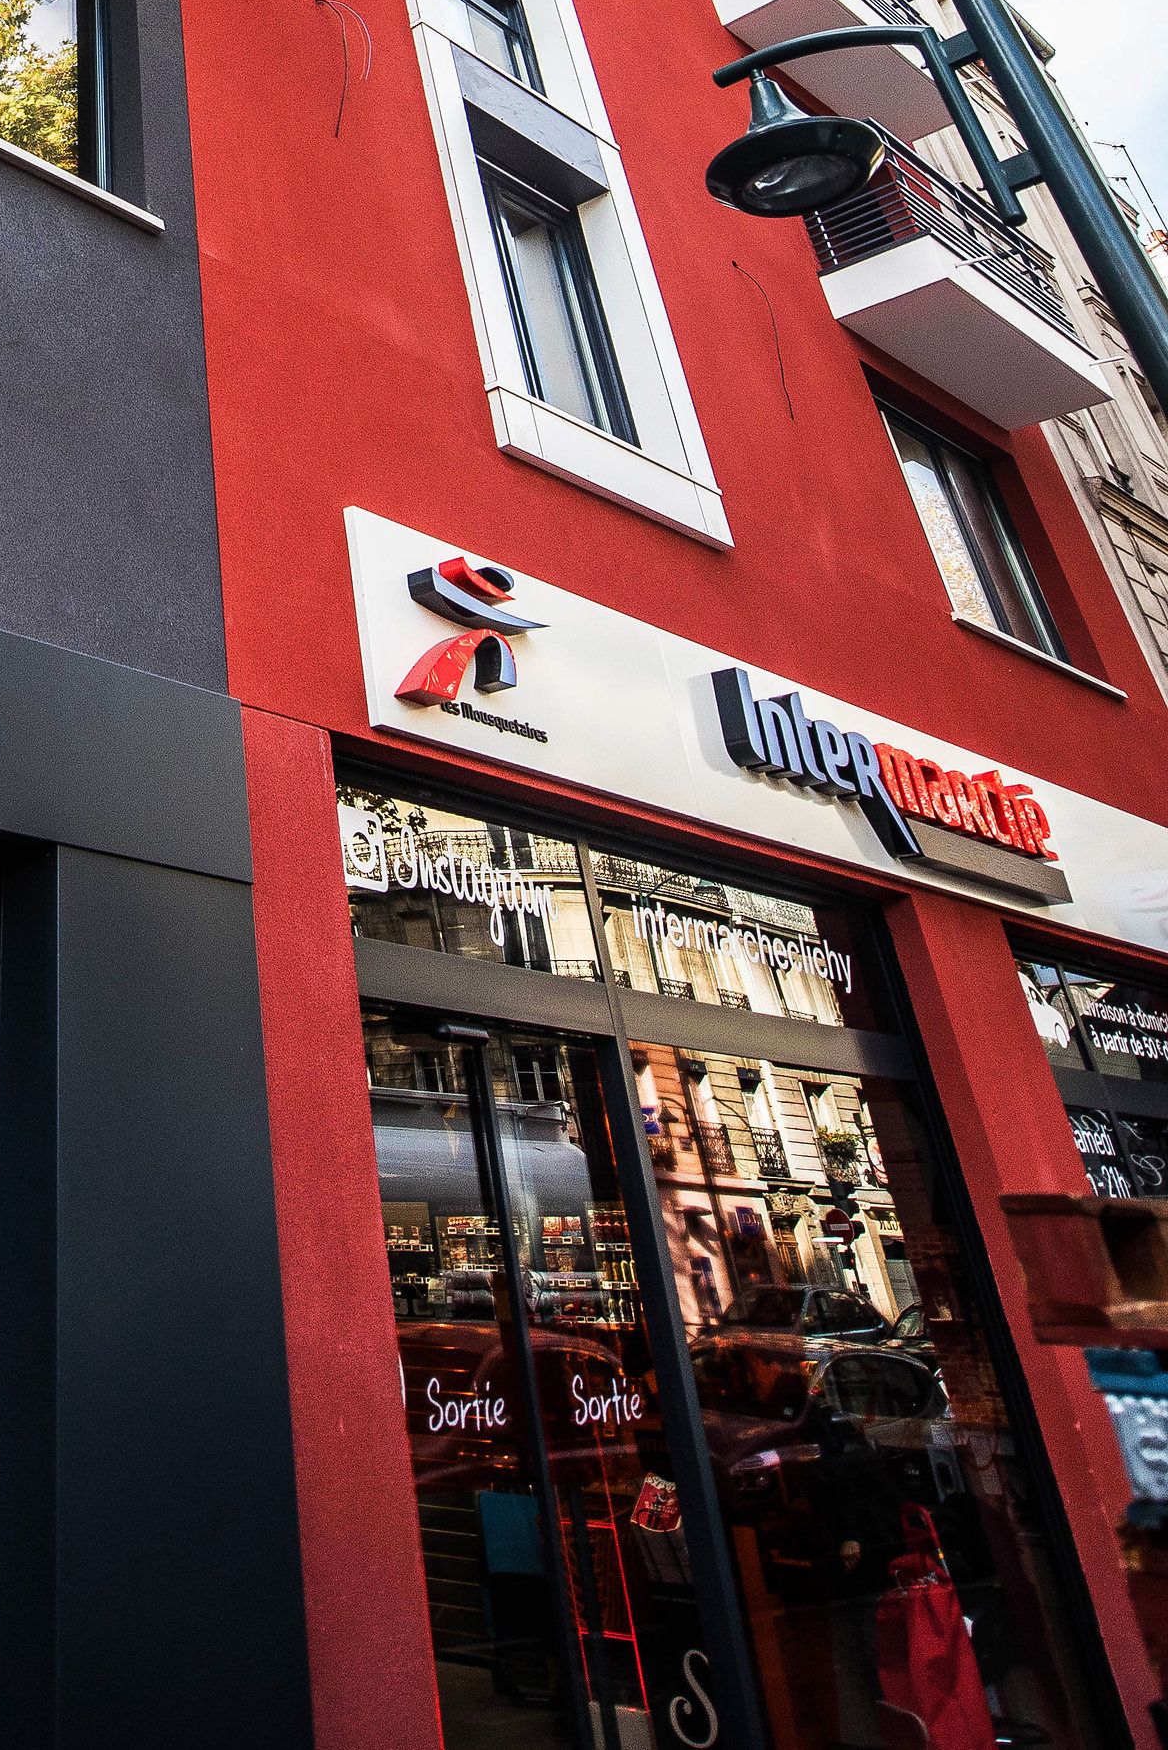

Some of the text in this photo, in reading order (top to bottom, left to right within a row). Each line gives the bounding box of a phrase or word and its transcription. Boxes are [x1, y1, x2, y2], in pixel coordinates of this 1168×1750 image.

[460, 701, 549, 744] Mousquetaires
[394, 825, 559, 947] Instagram
[630, 892, 852, 994] intermarcheclichy
[1081, 998, 1129, 1024] Livraison
[1089, 1024, 1102, 1048] à
[1099, 1030, 1130, 1055] partir
[1129, 1033, 1145, 1057] de
[426, 1377, 508, 1432] Sortie
[572, 1374, 644, 1426] Sortie
